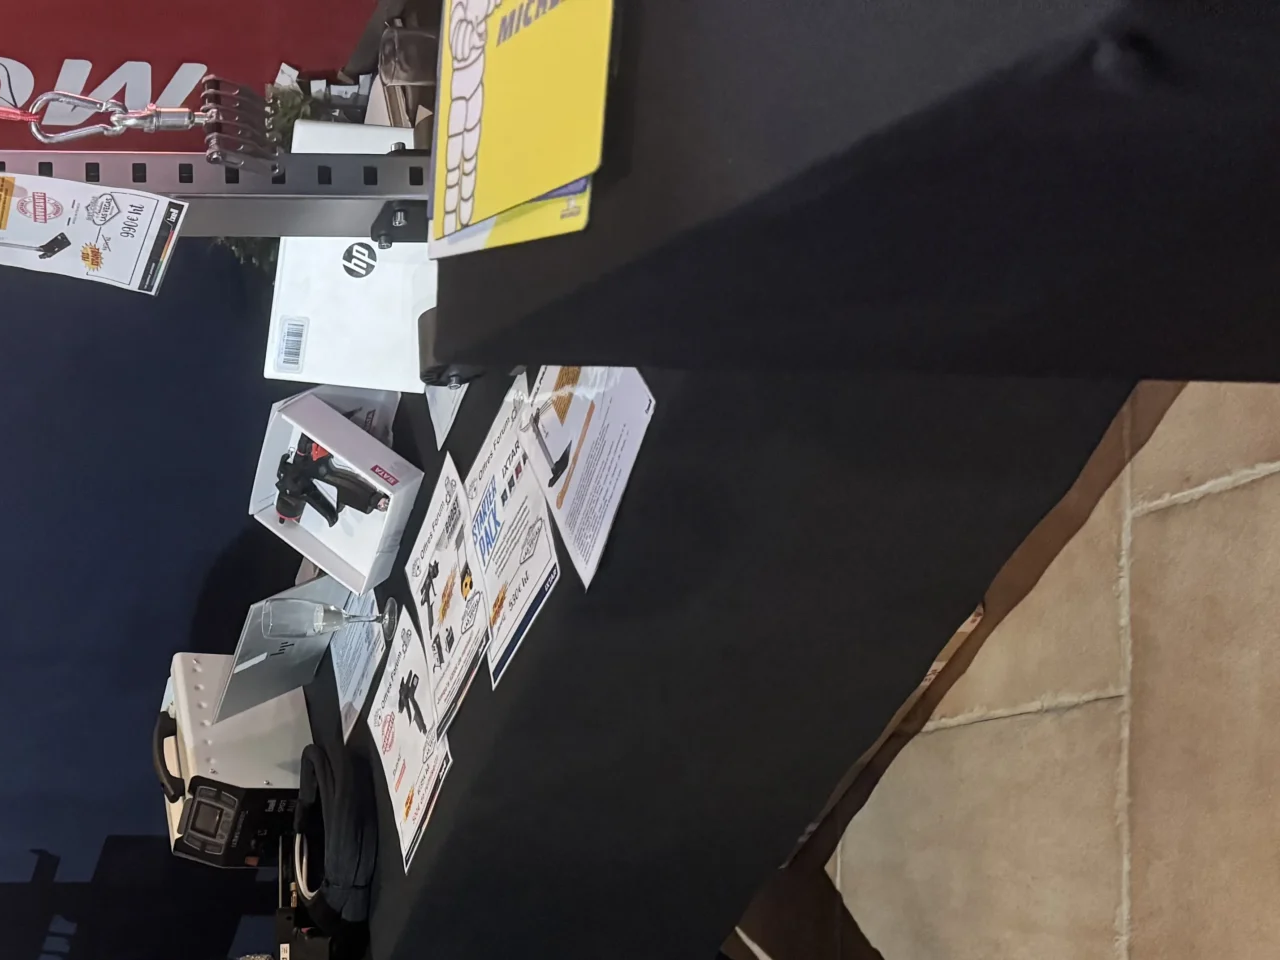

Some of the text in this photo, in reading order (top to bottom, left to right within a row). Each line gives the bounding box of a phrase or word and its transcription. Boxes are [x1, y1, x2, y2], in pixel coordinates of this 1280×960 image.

[120, 203, 145, 238] 990€ ht
[342, 244, 377, 276] hp
[478, 416, 510, 481] Offres Forum
[501, 439, 520, 479] IXTAR
[420, 501, 445, 560] Offres Forum
[471, 474, 497, 546] STARTER
[478, 499, 501, 567] PACK
